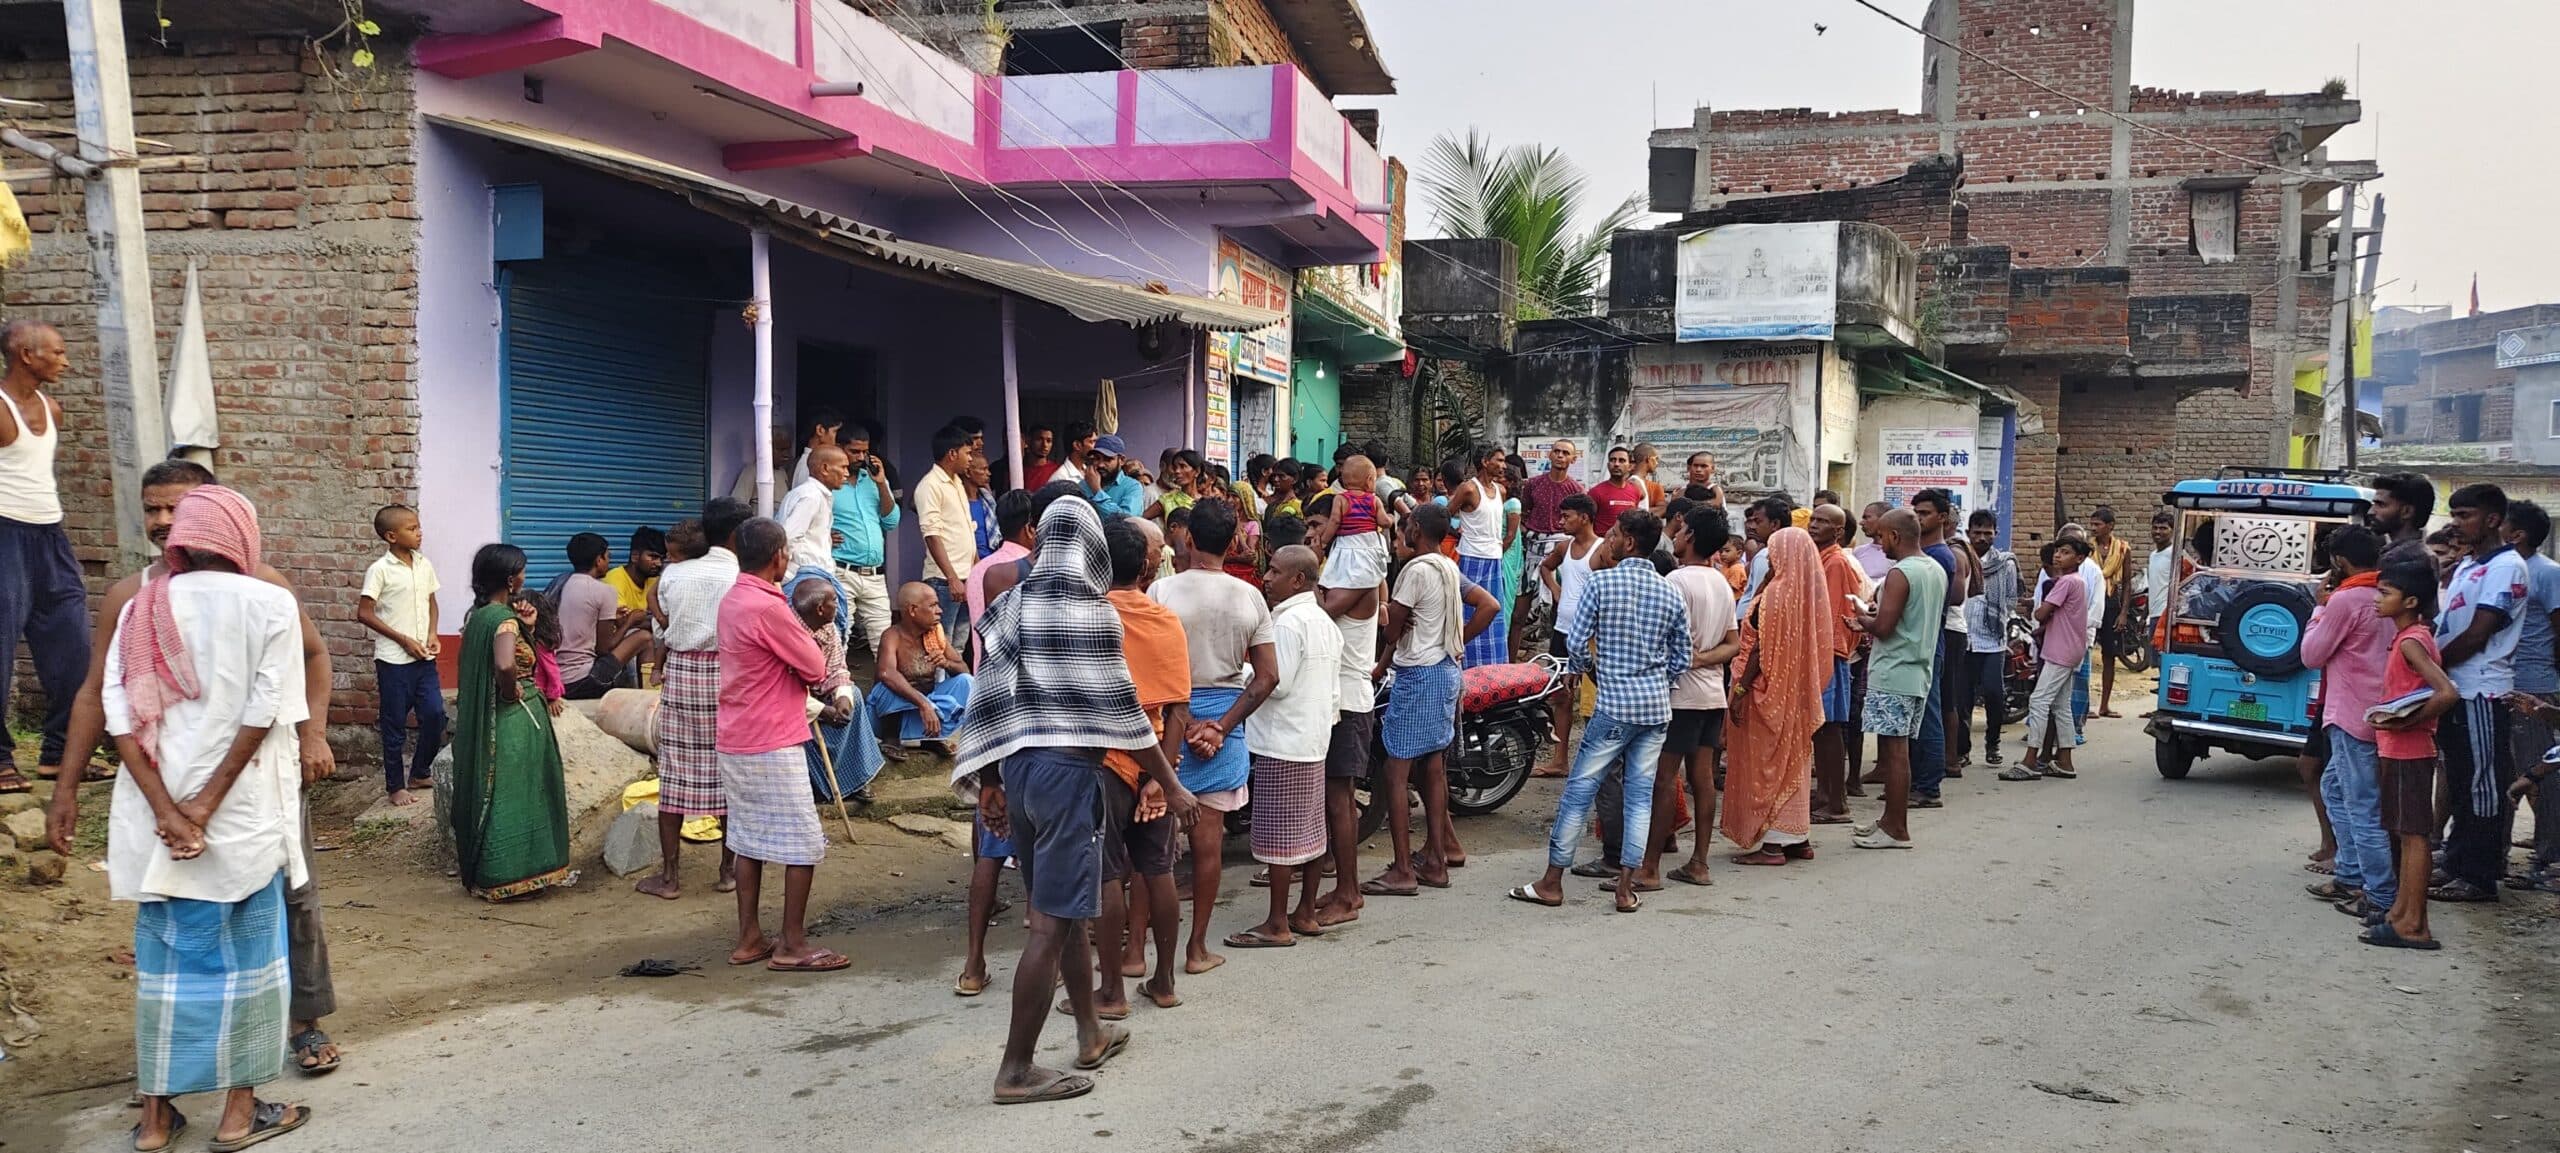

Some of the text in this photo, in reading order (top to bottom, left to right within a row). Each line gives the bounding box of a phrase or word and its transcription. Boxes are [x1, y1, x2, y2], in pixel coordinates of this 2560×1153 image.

[1886, 453, 1913, 466] जनता
[1917, 453, 1946, 468] साइबर
[2216, 482, 2313, 495] CITY LIFE
